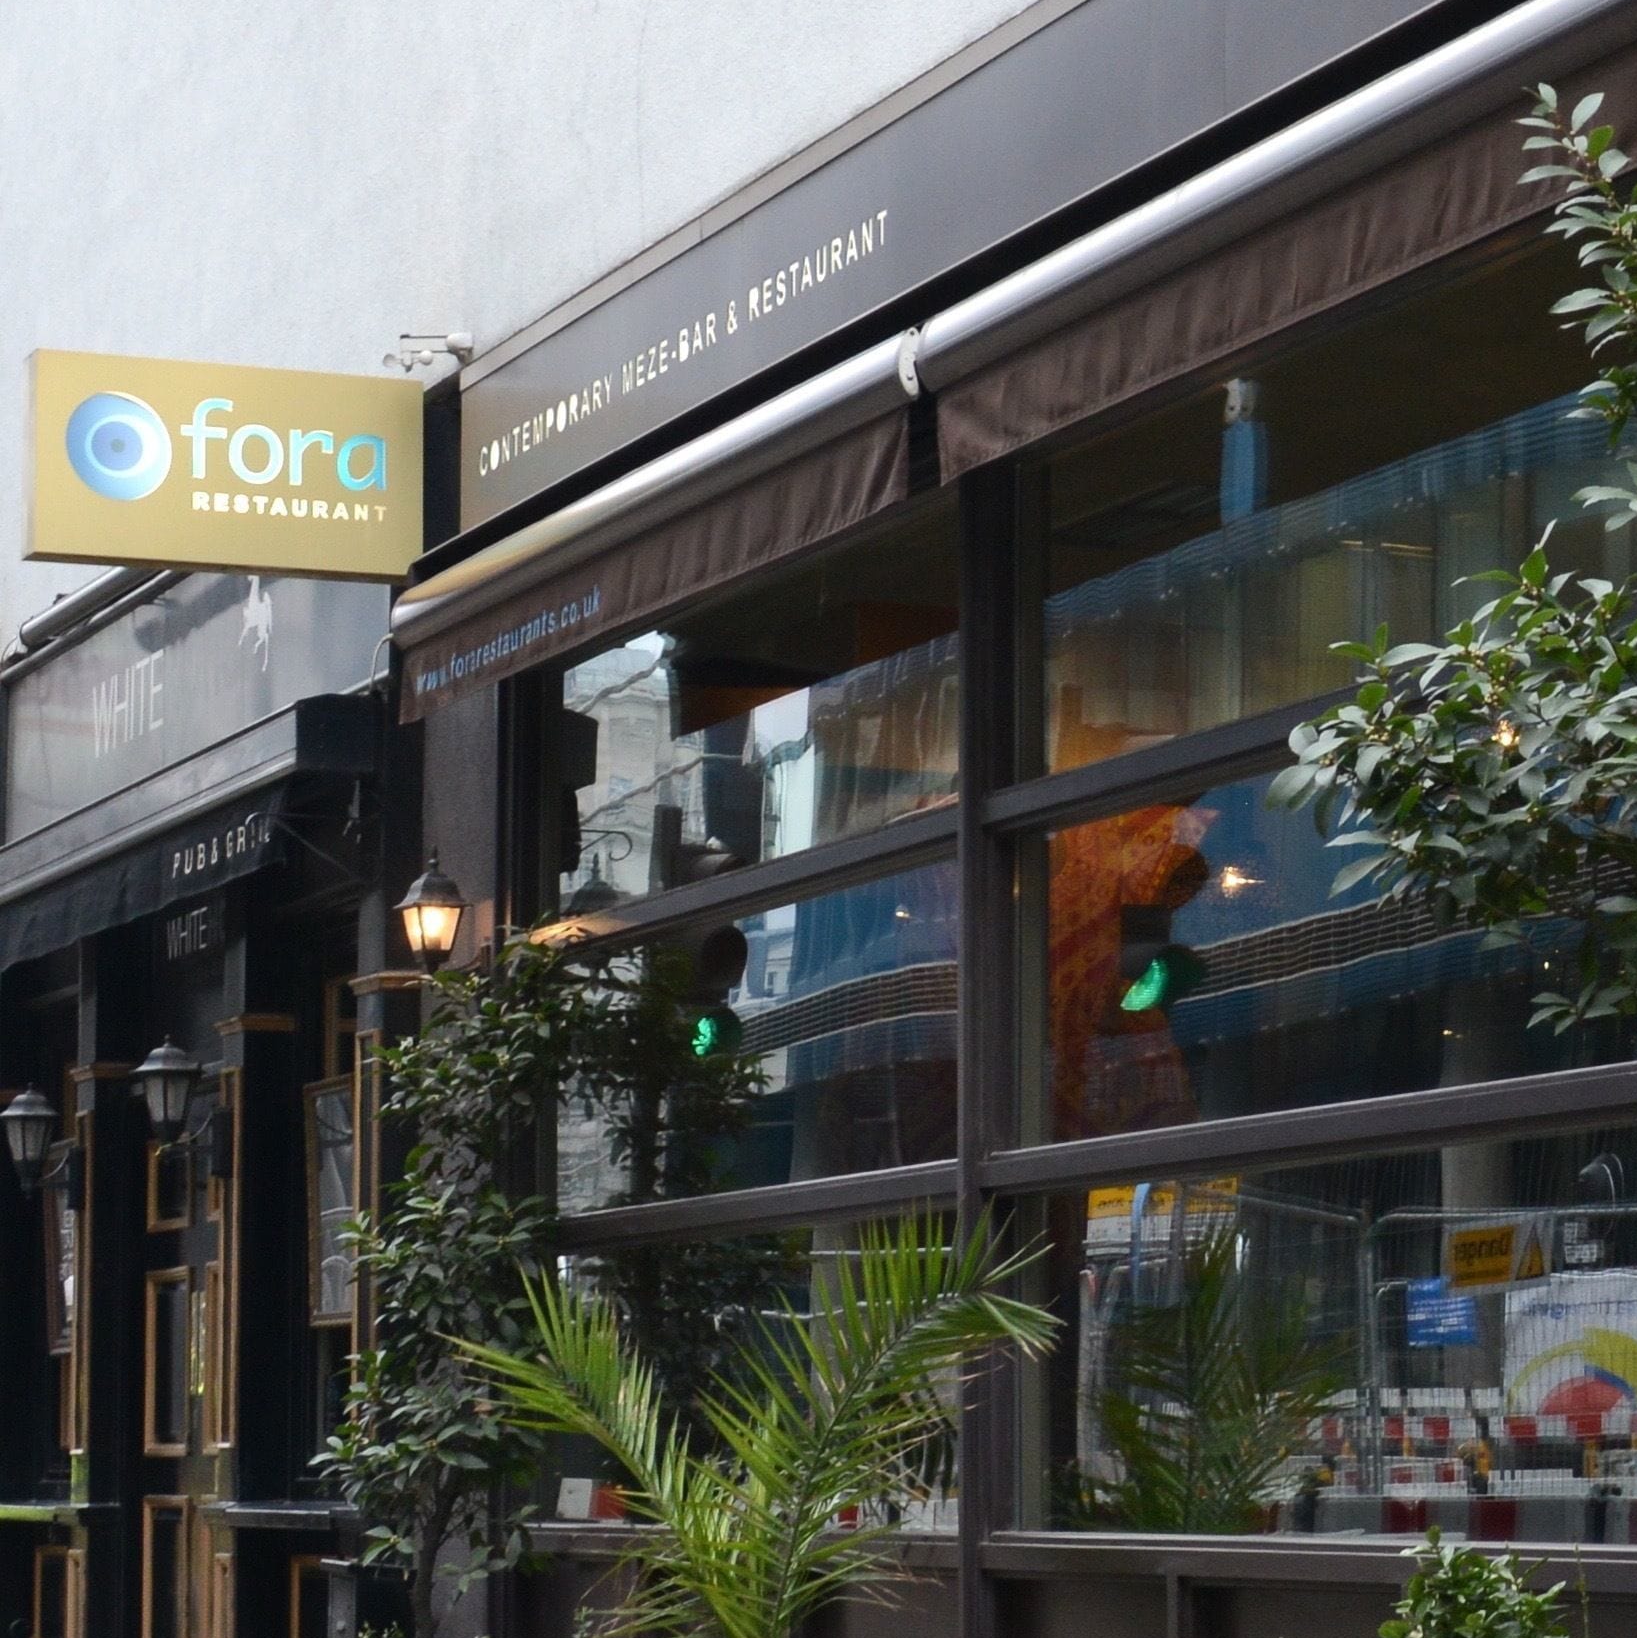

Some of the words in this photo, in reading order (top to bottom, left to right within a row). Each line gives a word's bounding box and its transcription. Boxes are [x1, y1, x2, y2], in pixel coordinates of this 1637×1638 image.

[478, 373, 613, 476] CONTEMPORARY
[622, 313, 717, 396] MEZE-BAR
[727, 300, 738, 334] &
[748, 210, 888, 323] RESTAURANT
[180, 397, 387, 492] fora
[192, 491, 387, 522] RESTAURANT
[92, 648, 165, 759] WHITE
[172, 843, 206, 879] PUB
[211, 837, 218, 865] &
[167, 906, 208, 960] WHITE
